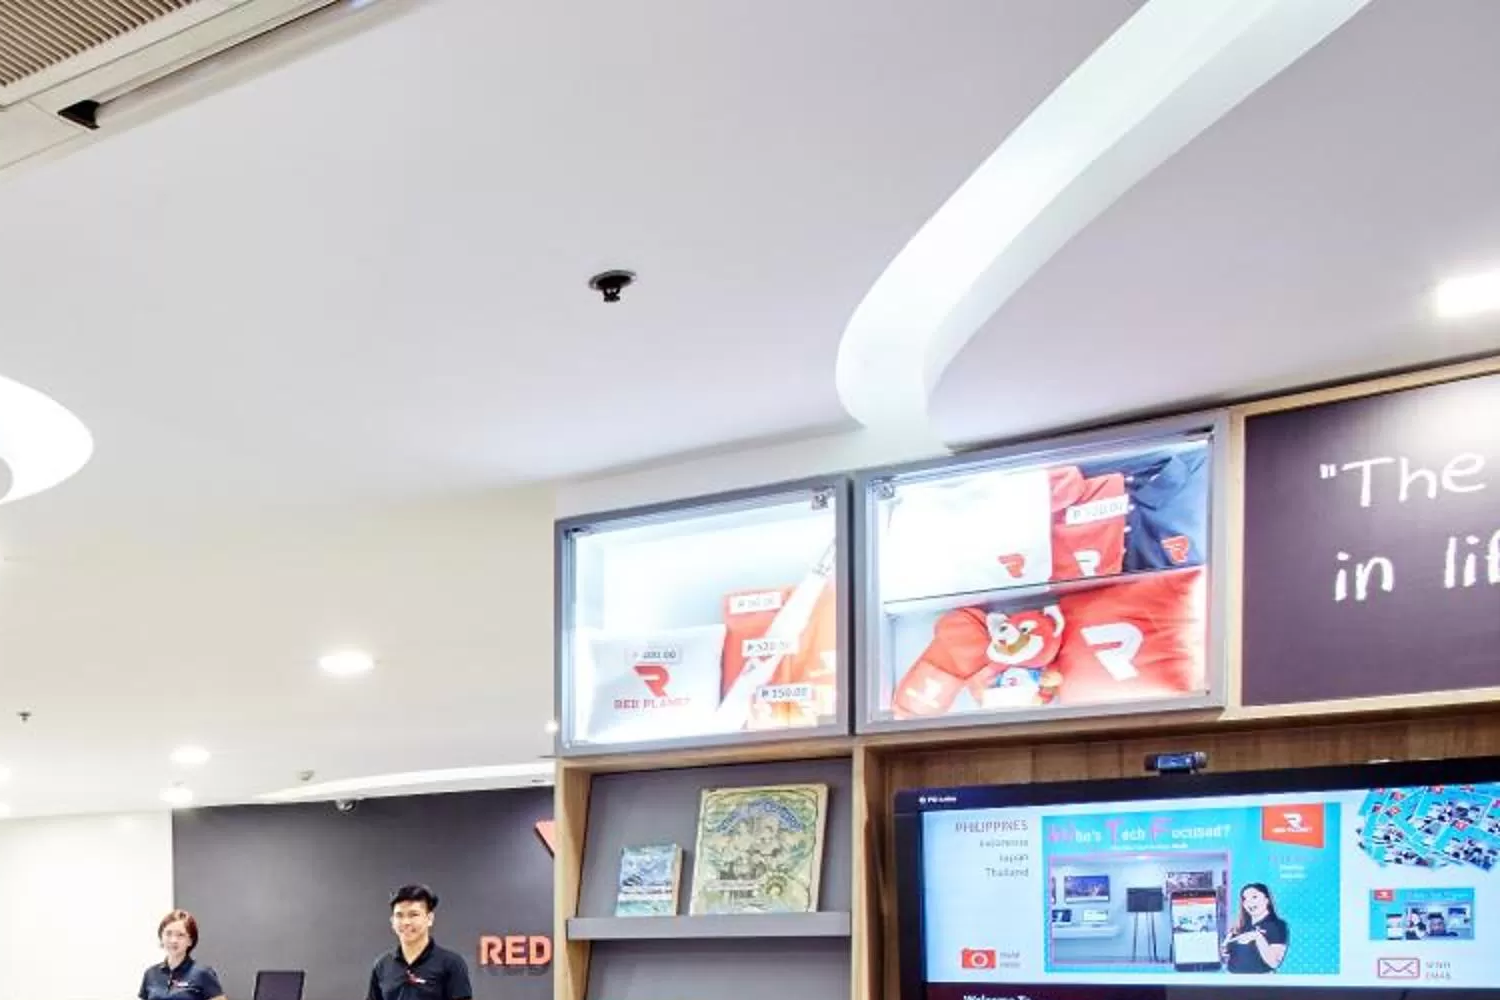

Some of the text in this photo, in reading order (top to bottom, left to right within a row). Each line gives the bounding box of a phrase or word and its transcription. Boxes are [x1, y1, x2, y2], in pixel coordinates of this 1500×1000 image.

[1334, 551, 1395, 603] in
[955, 819, 1029, 833] PHILIPPINES
[479, 935, 552, 966] RED
